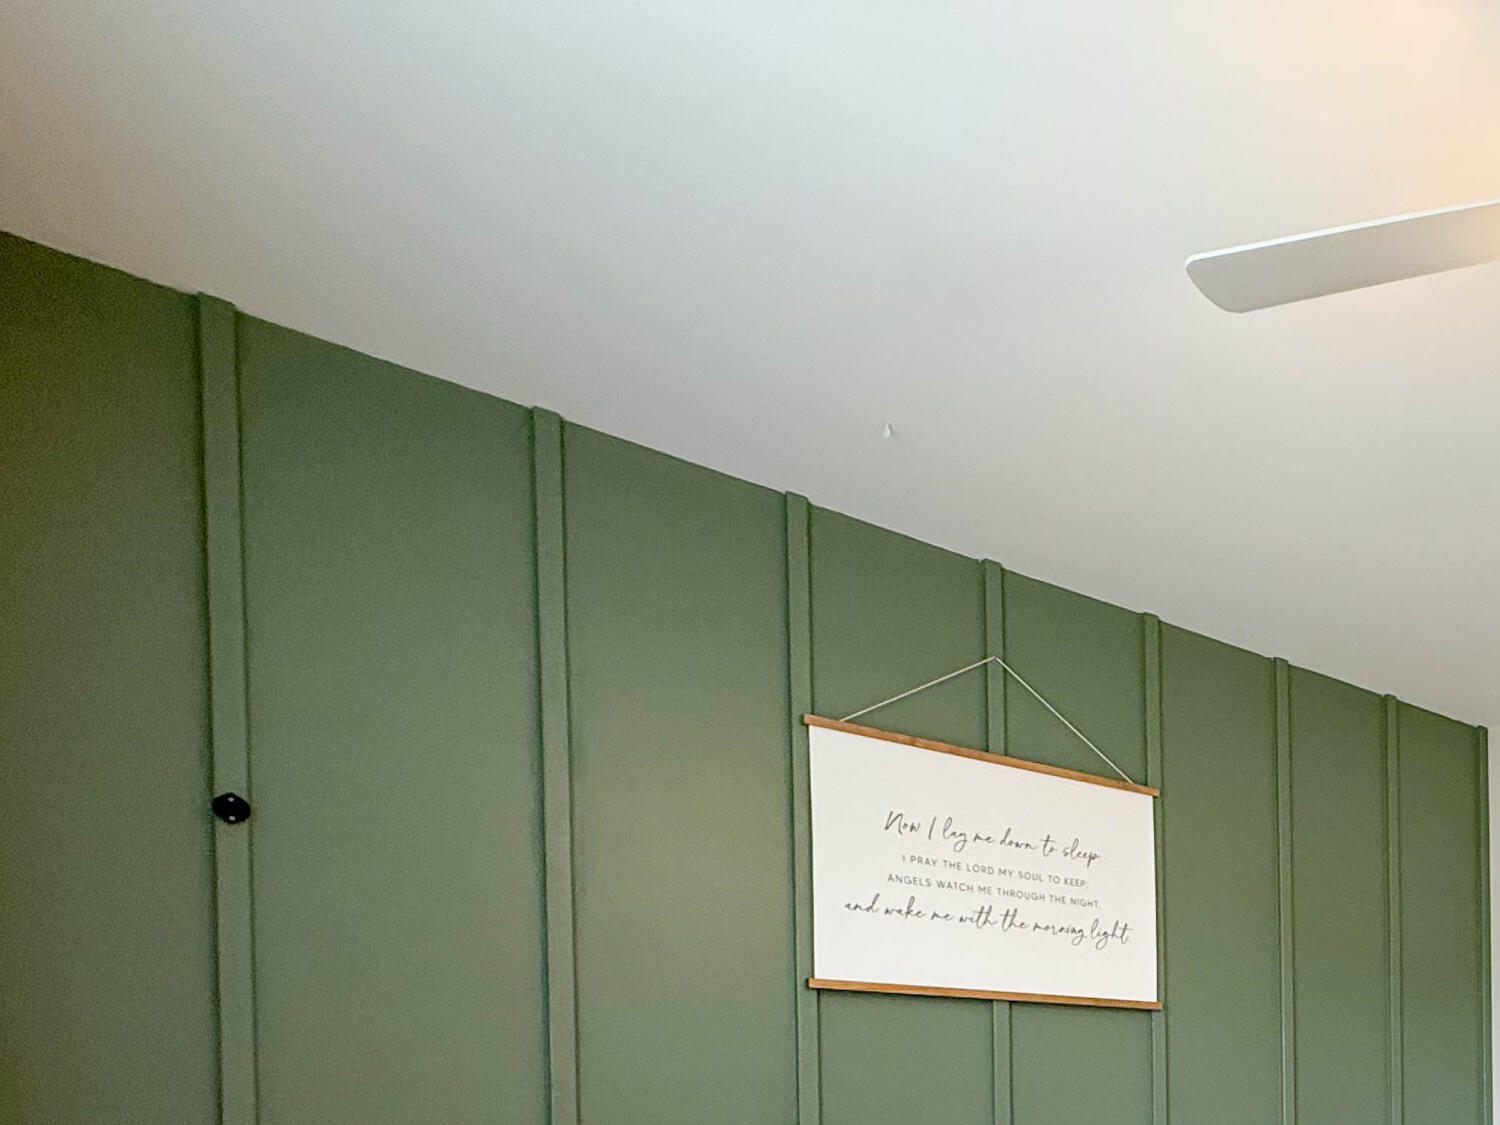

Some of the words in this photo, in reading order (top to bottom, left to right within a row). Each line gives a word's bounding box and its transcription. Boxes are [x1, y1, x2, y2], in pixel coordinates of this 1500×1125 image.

[884, 810, 920, 835] Now
[928, 816, 936, 840] I
[943, 817, 968, 852] lay
[974, 832, 996, 844] me
[1000, 828, 1038, 850] down
[1040, 834, 1058, 857] to
[910, 855, 938, 866] PRAY
[943, 860, 962, 871] THE
[967, 864, 995, 876] LORD
[998, 868, 1017, 878] MY
[1018, 870, 1043, 882] SOUL
[1048, 874, 1060, 884] TO
[888, 874, 932, 887] ANGELS
[936, 880, 974, 894] WATCH
[978, 886, 993, 896] ME
[997, 887, 1046, 902] THROUGH
[1049, 894, 1066, 904] THE
[844, 894, 881, 916] and
[884, 896, 926, 920] wake
[931, 911, 954, 922] me
[960, 905, 998, 930] with
[1000, 908, 1029, 932] the
[1032, 922, 1088, 946] morning
[1090, 918, 1134, 950] light
